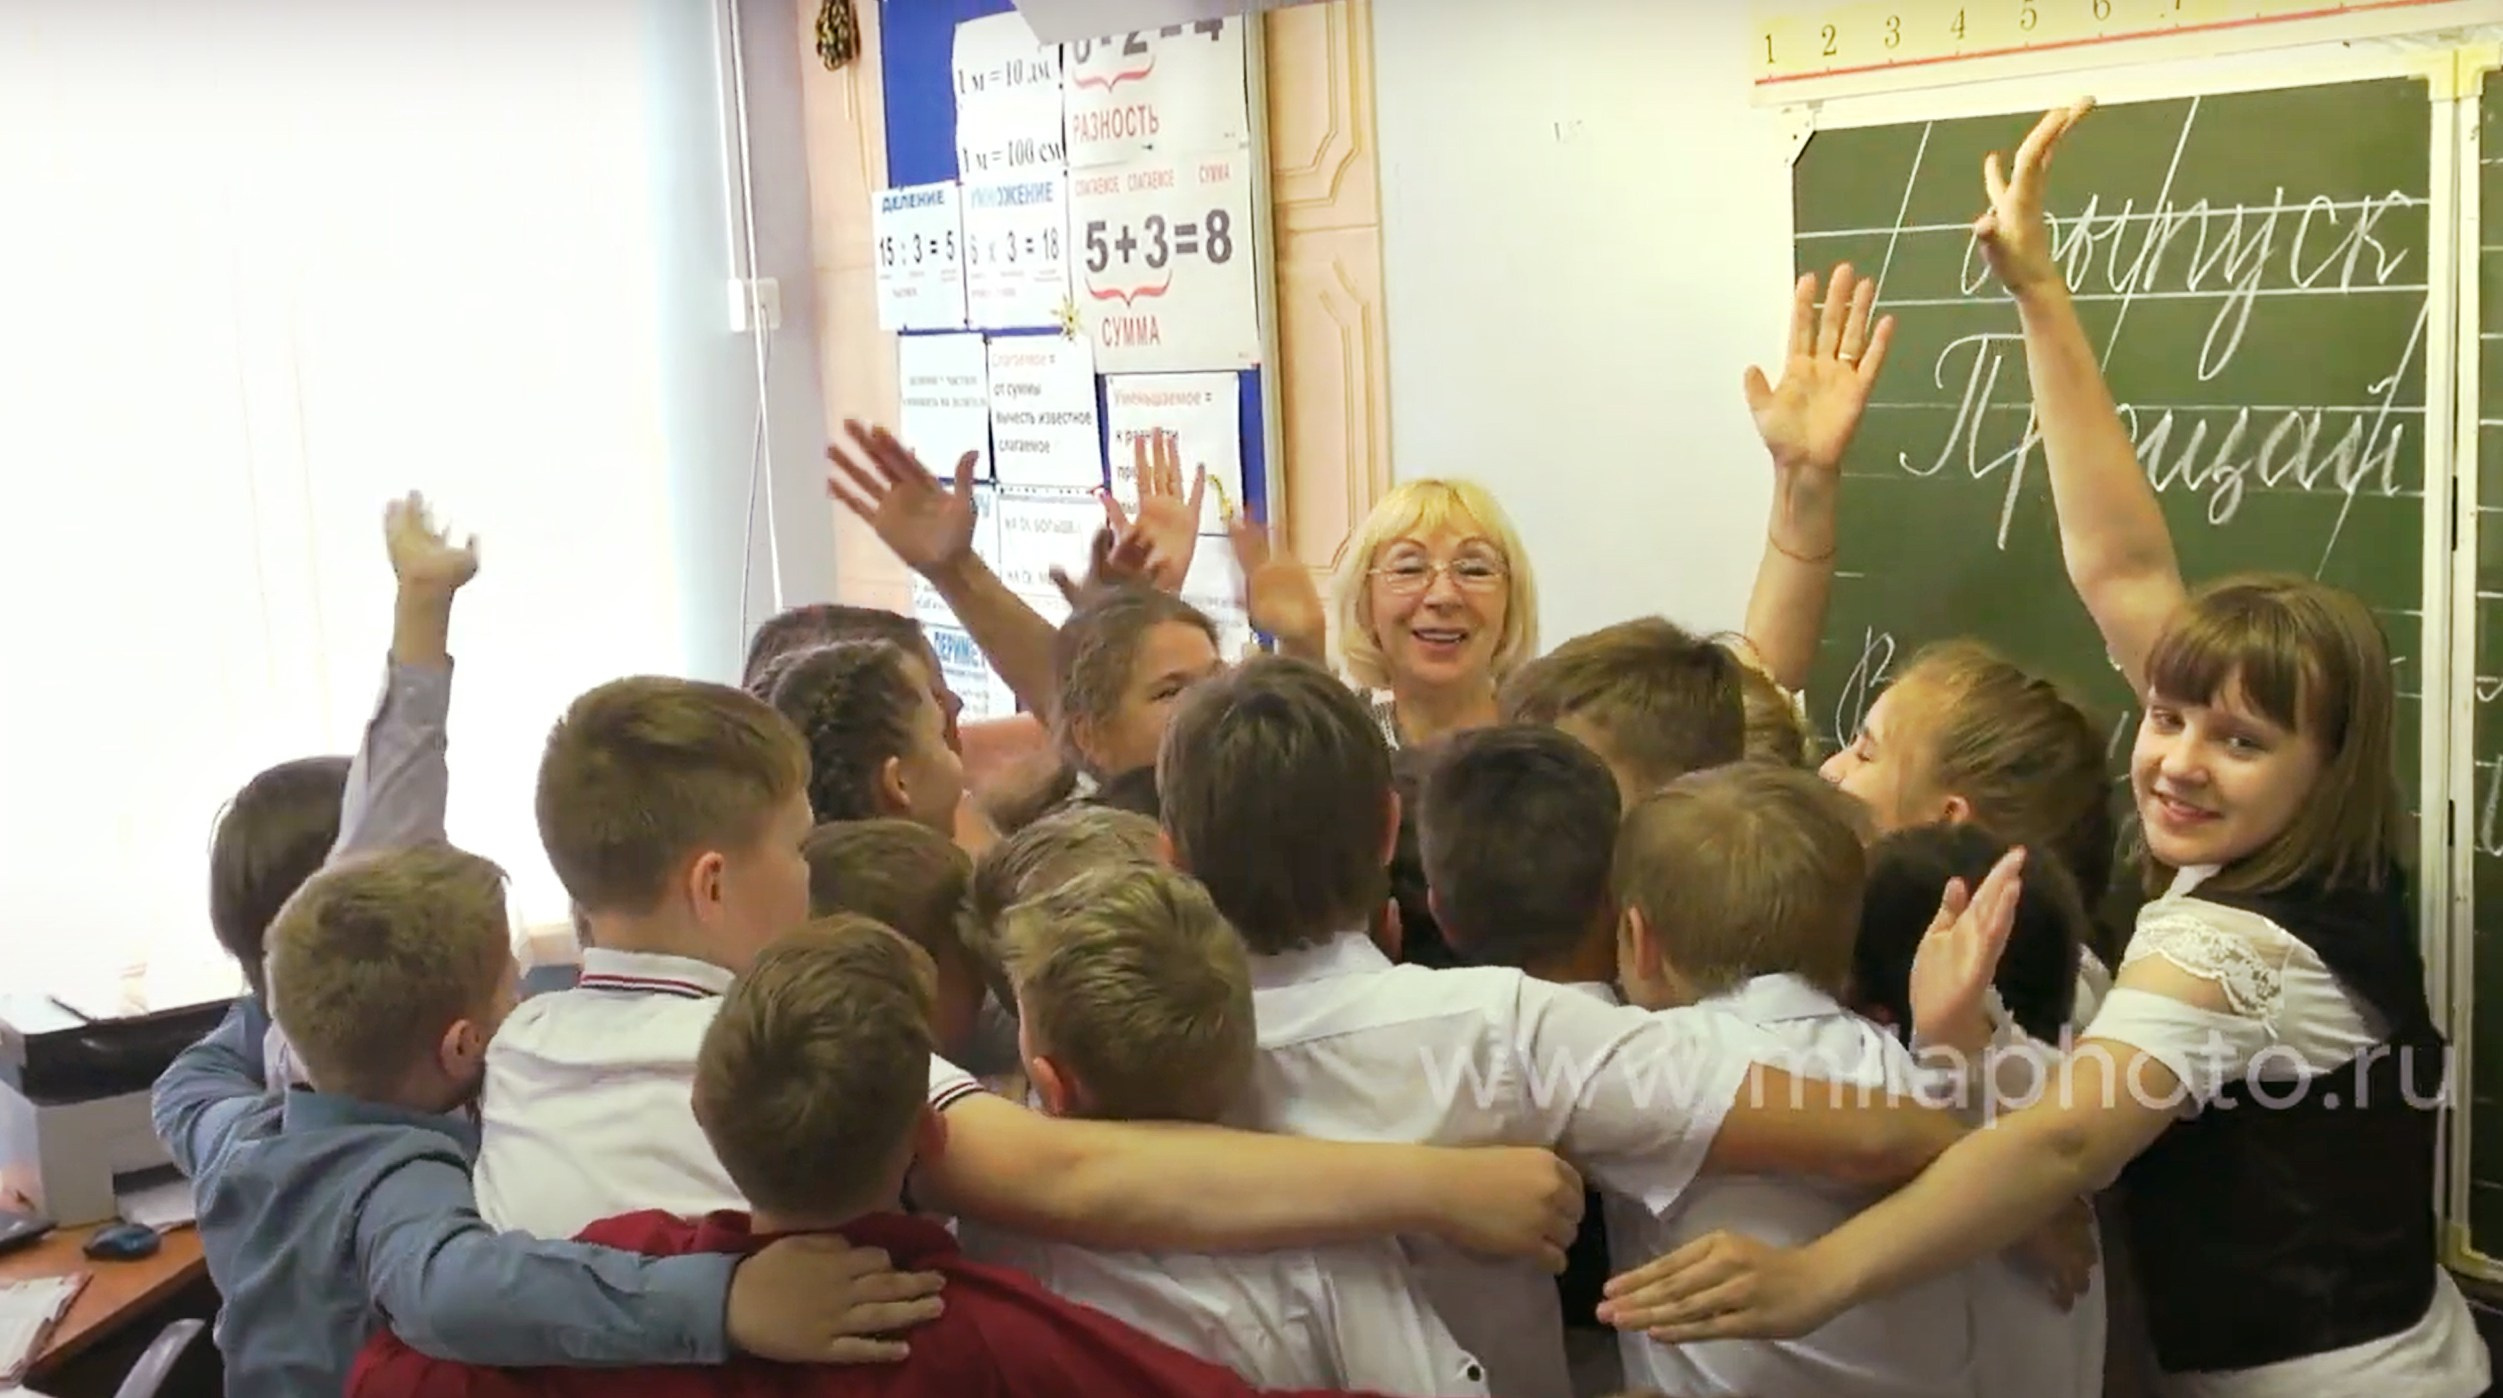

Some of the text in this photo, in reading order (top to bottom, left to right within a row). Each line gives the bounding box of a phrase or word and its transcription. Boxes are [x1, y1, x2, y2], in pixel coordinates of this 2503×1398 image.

[1765, 33, 1776, 64] 1
[1821, 24, 1837, 56] 2
[1884, 15, 1901, 49] 3
[1950, 7, 1965, 40] 4
[1073, 103, 1160, 145] РАЗНОСТЬ
[1008, 137, 1035, 167] 100
[882, 189, 945, 214] ДЕЛЕНИЕ
[879, 235, 895, 267] 15
[913, 232, 923, 265] 3
[946, 229, 956, 262] 5
[1007, 229, 1018, 263] 3
[1043, 226, 1060, 261] 18
[1101, 313, 1161, 348] СУММА
[1038, 411, 1093, 426] известное
